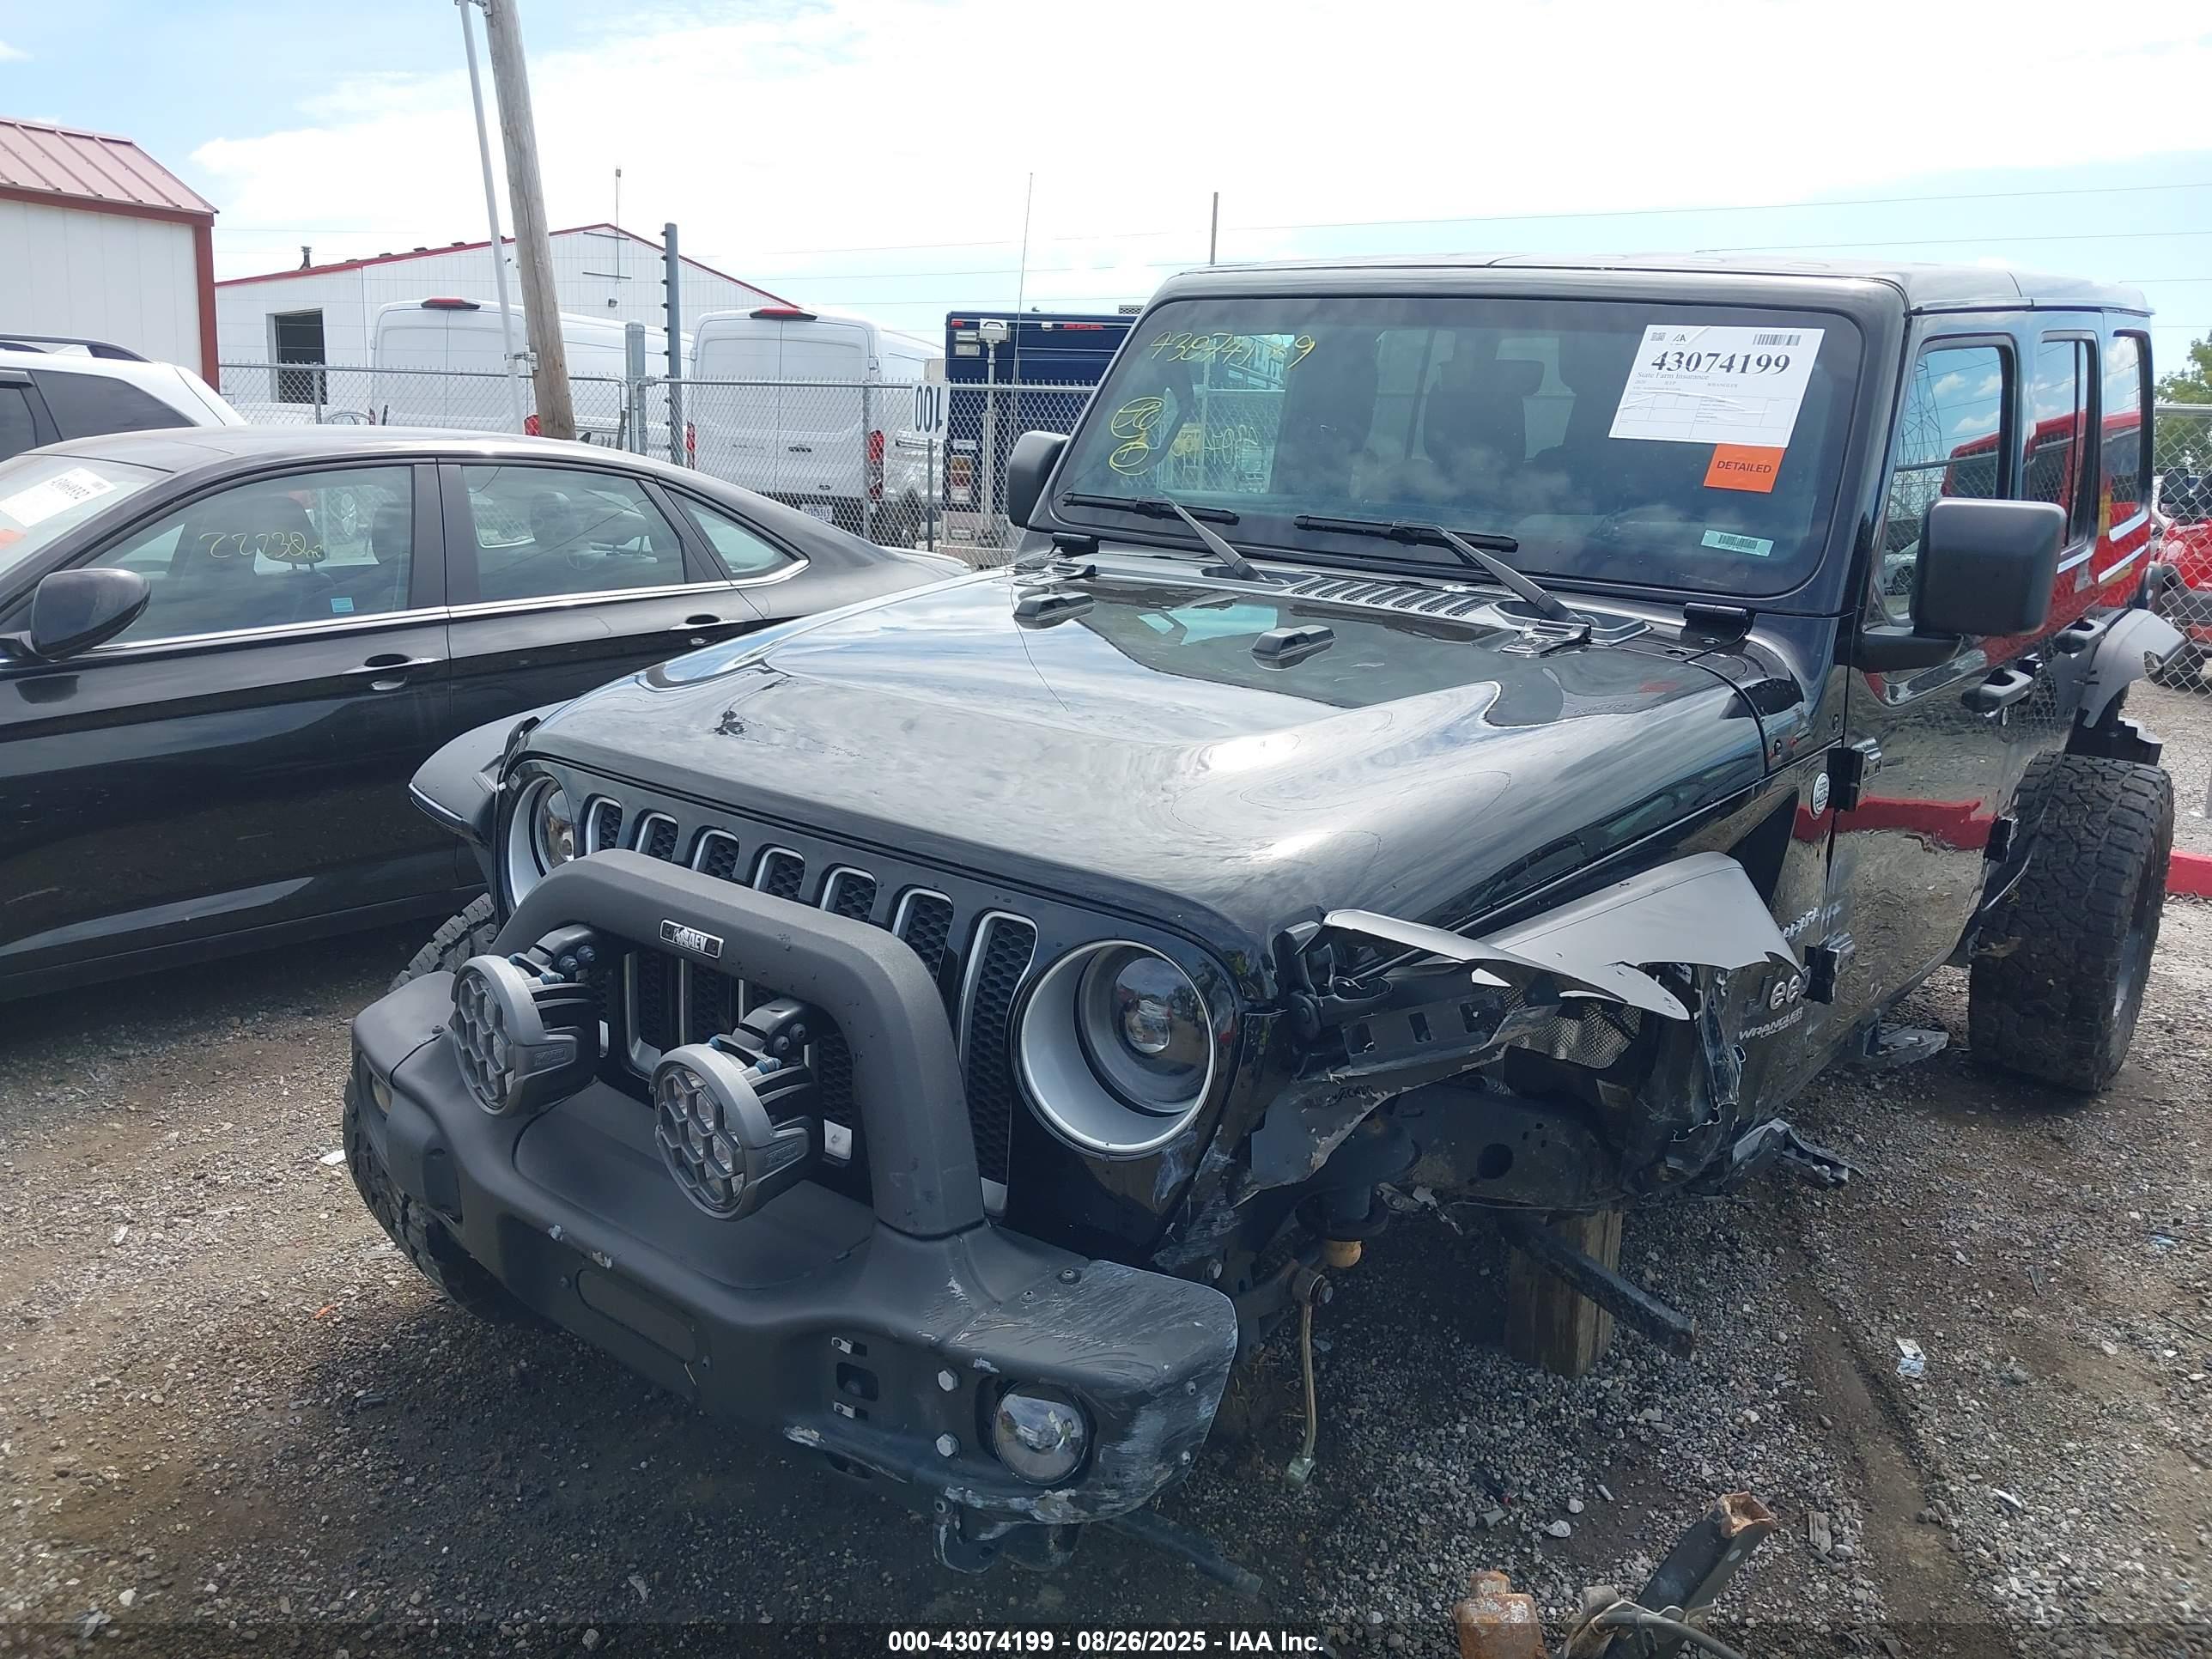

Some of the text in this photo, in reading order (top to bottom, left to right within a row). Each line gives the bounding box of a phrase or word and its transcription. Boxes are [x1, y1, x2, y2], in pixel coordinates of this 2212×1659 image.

[1151, 331, 1316, 369] 4307419
[1650, 351, 1790, 375] 43074199
[1717, 460, 1772, 474] DETAILED
[689, 932, 708, 951] AEV
[1739, 1006, 1803, 1041] WRANGLER
[1760, 1015, 1802, 1039] UNLIMITED
